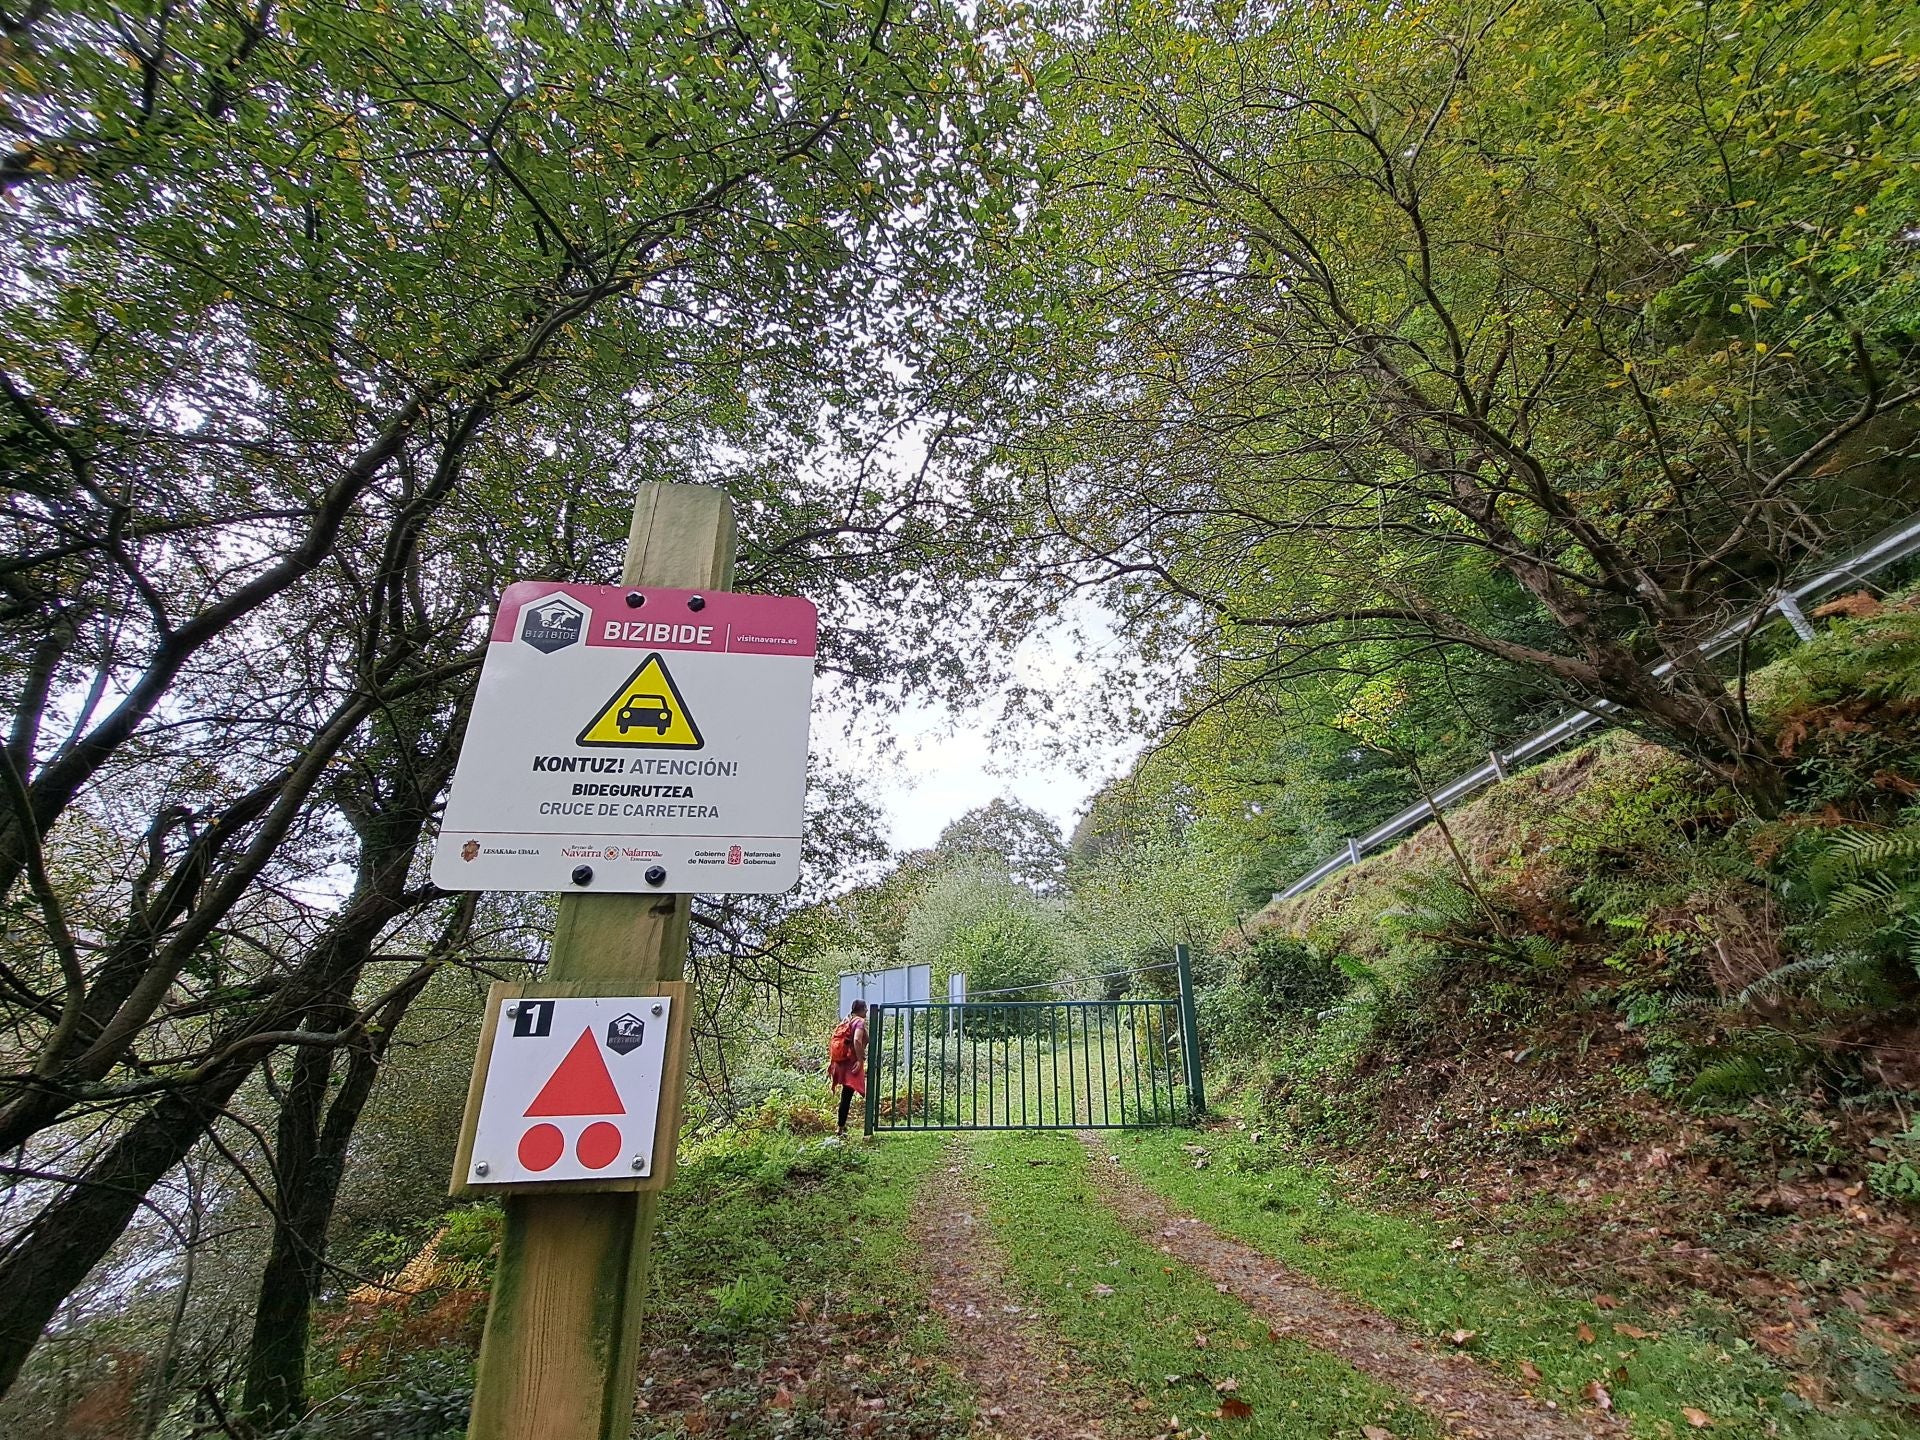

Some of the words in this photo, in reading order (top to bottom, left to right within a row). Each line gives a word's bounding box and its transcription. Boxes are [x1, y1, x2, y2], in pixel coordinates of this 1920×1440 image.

[525, 629, 576, 640] BIZIBIDE
[603, 621, 713, 645] BIZIBIDE
[736, 634, 798, 645] visitnavarra.es
[532, 755, 625, 773] KONTUZ!
[629, 757, 738, 776] ATENCIÓN!
[571, 783, 694, 798] BIDEGURUTZEA
[539, 802, 595, 816] CRUCE
[597, 803, 620, 816] DE
[623, 804, 720, 818] CARRETERA
[561, 848, 602, 858] Navarra
[526, 1003, 542, 1034] 1
